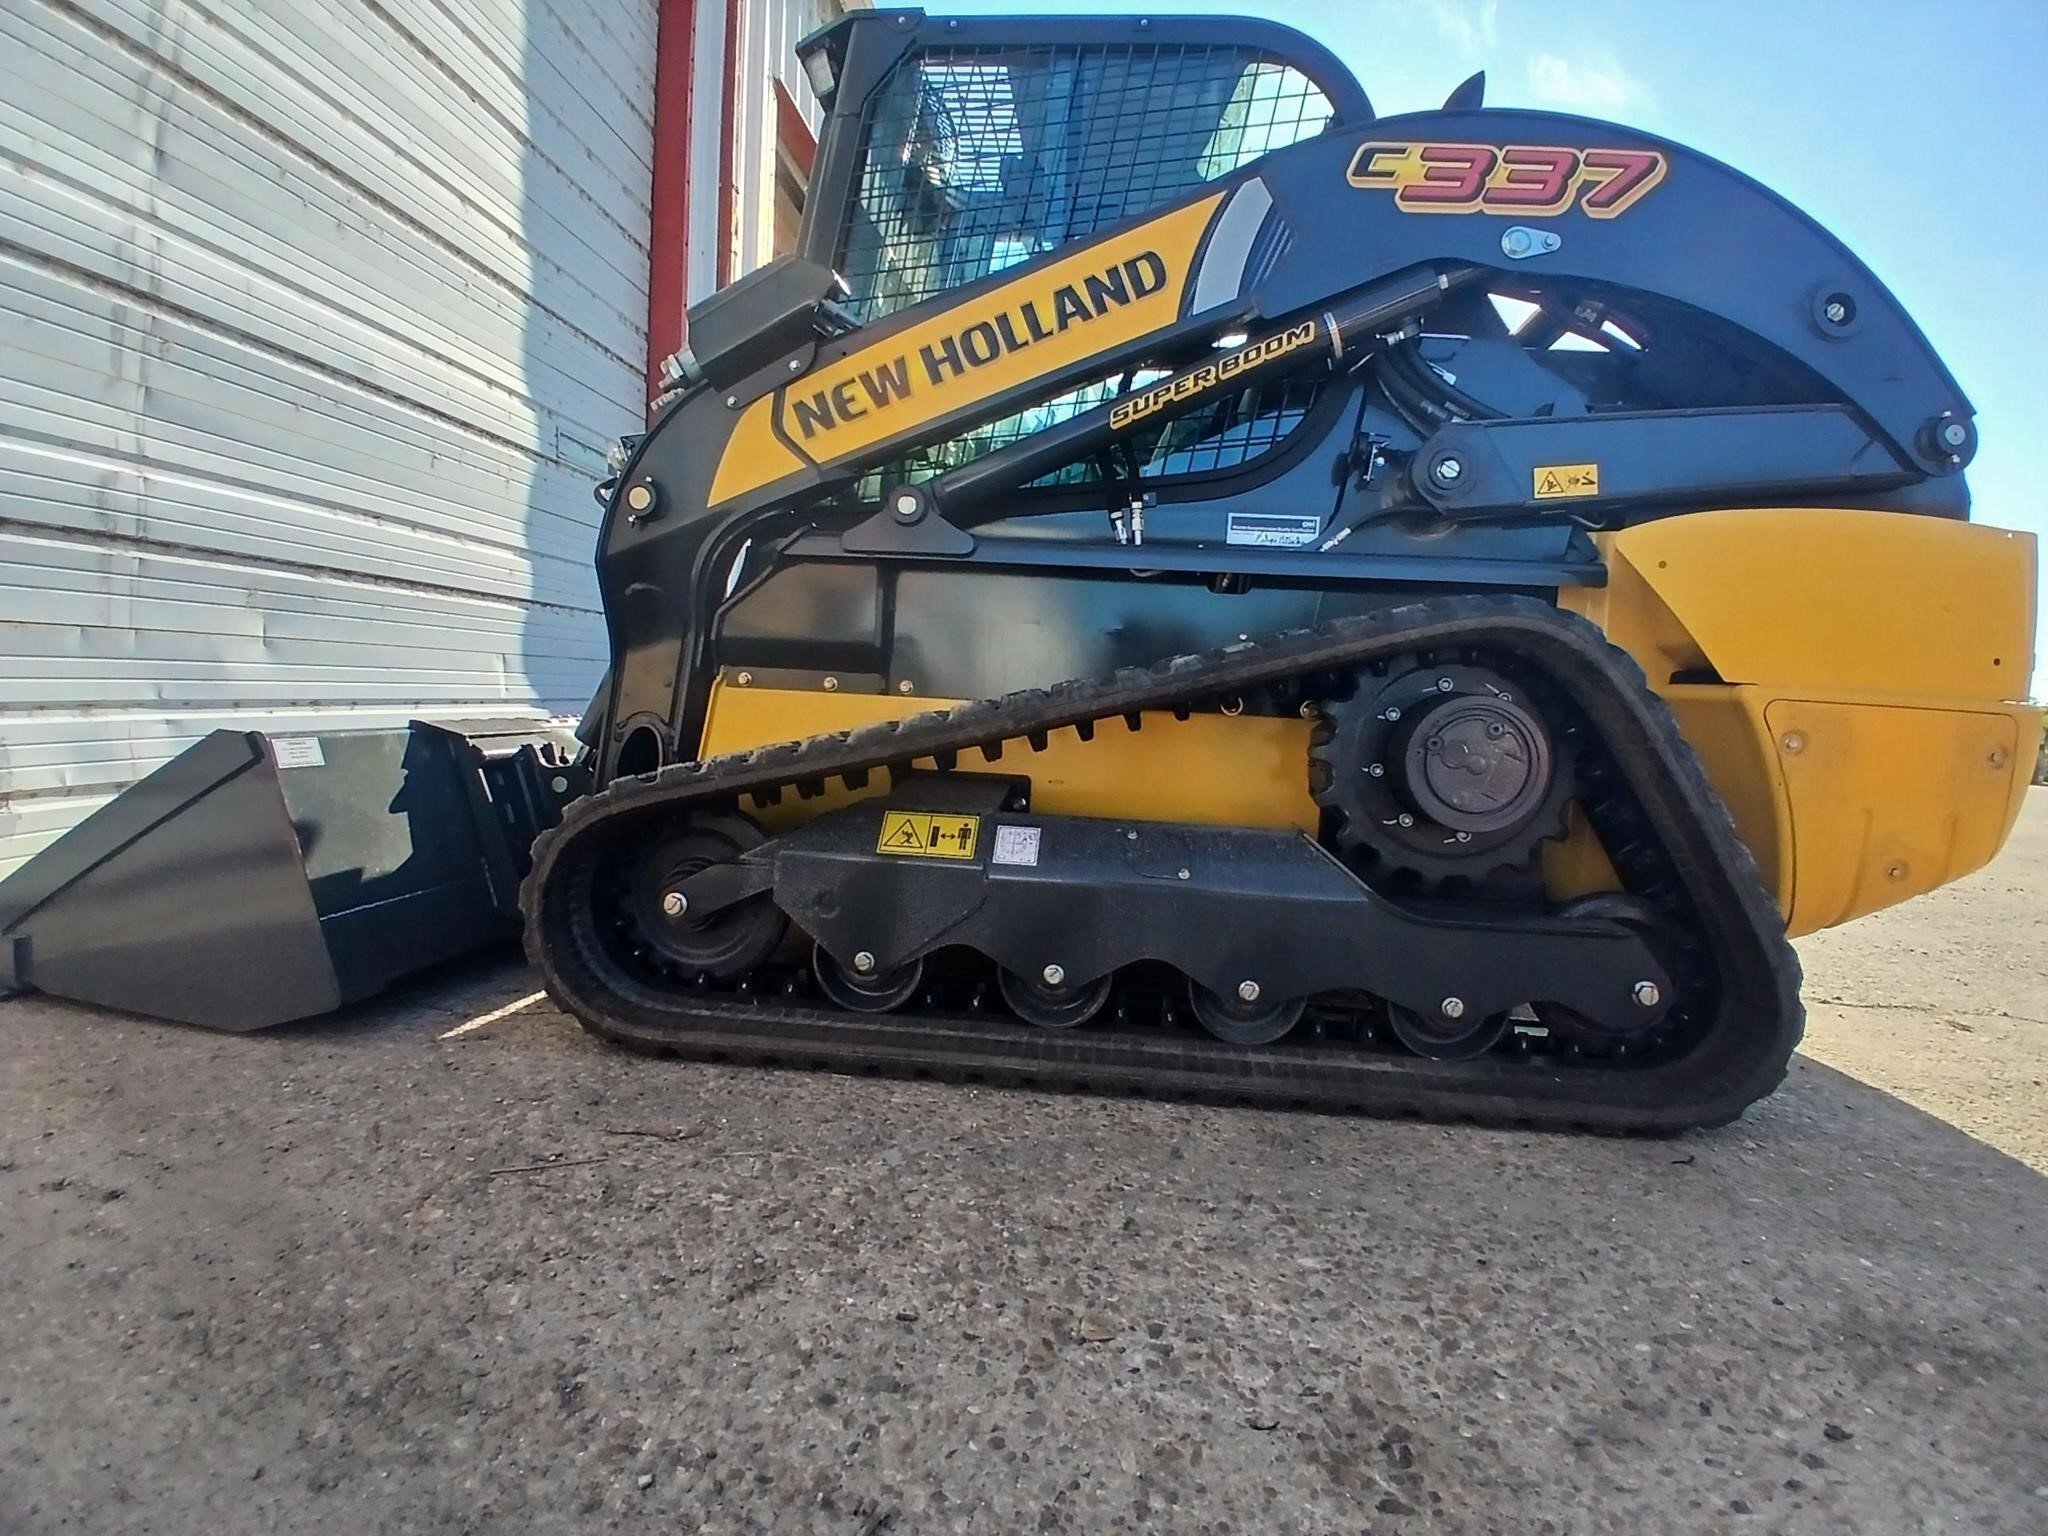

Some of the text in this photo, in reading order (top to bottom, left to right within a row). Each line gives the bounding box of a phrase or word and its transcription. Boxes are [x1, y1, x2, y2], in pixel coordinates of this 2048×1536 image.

[1347, 142, 1666, 218] C337
[793, 250, 1167, 440] NEW HOLLAND
[1110, 321, 1315, 430] SUPER BOOM
